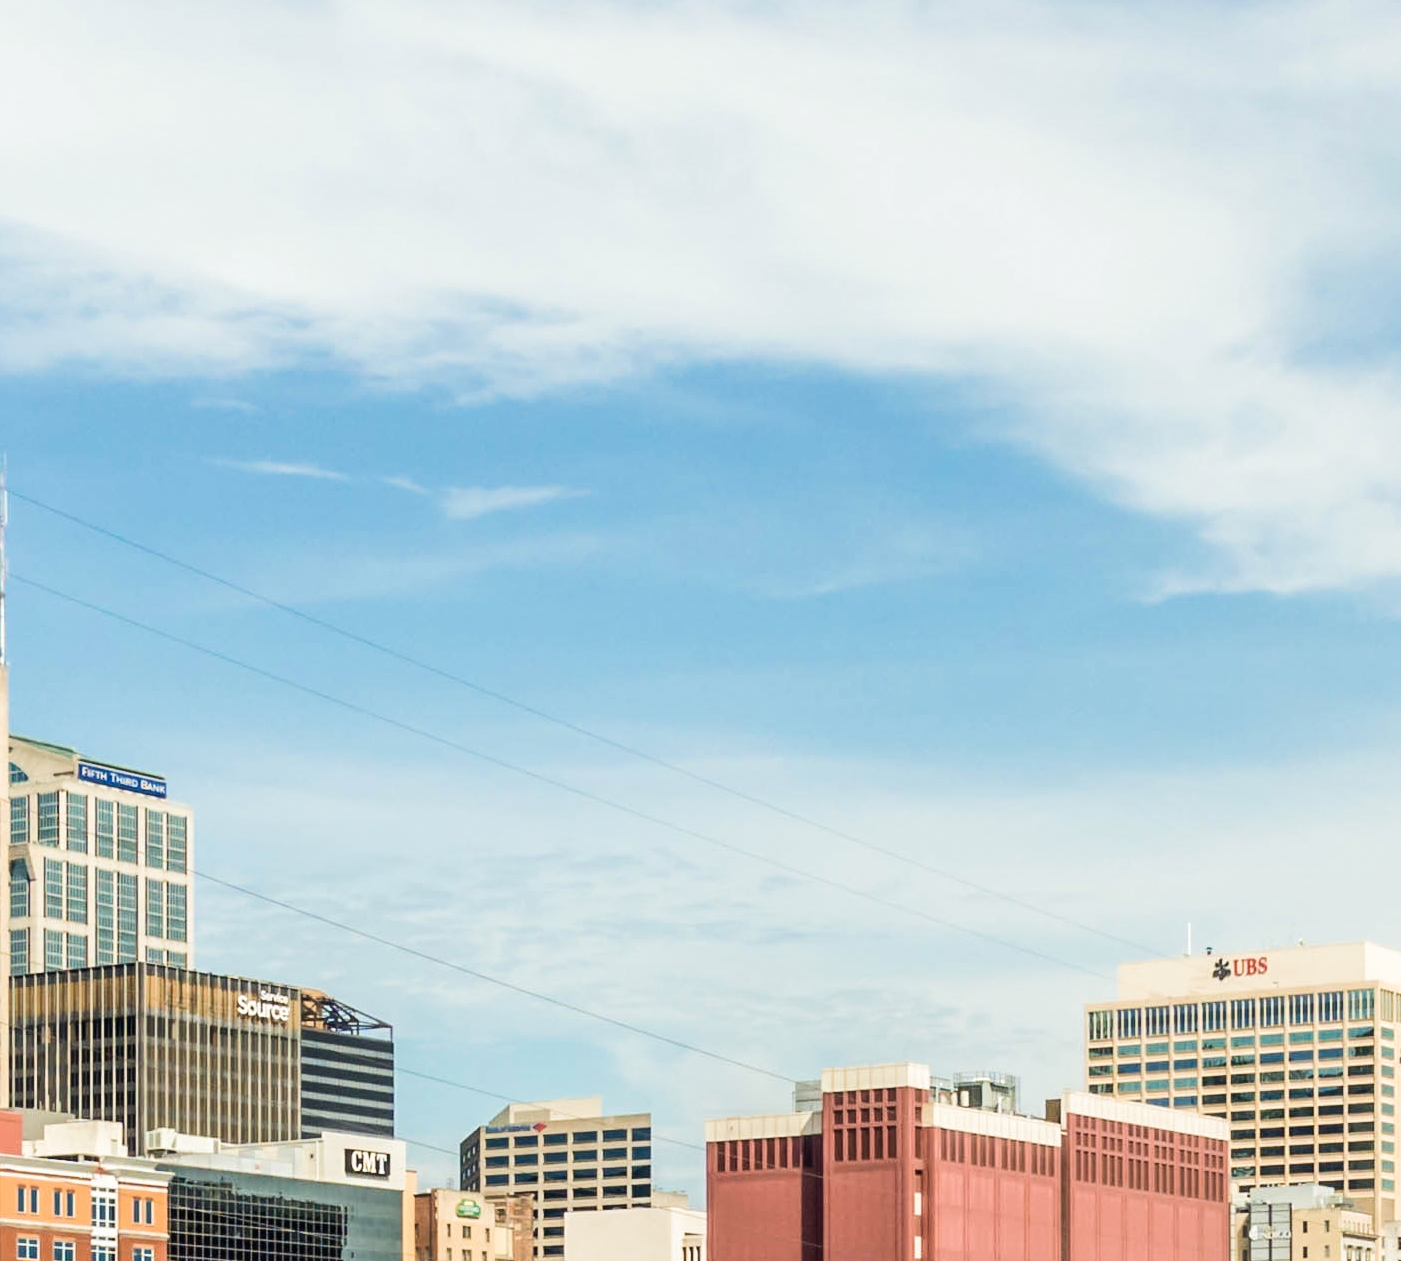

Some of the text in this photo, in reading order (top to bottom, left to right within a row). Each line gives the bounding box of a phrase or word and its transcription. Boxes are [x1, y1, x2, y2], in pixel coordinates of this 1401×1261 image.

[1233, 957, 1268, 977] UBS
[237, 995, 290, 1021] Source
[351, 1150, 388, 1175] CMT
